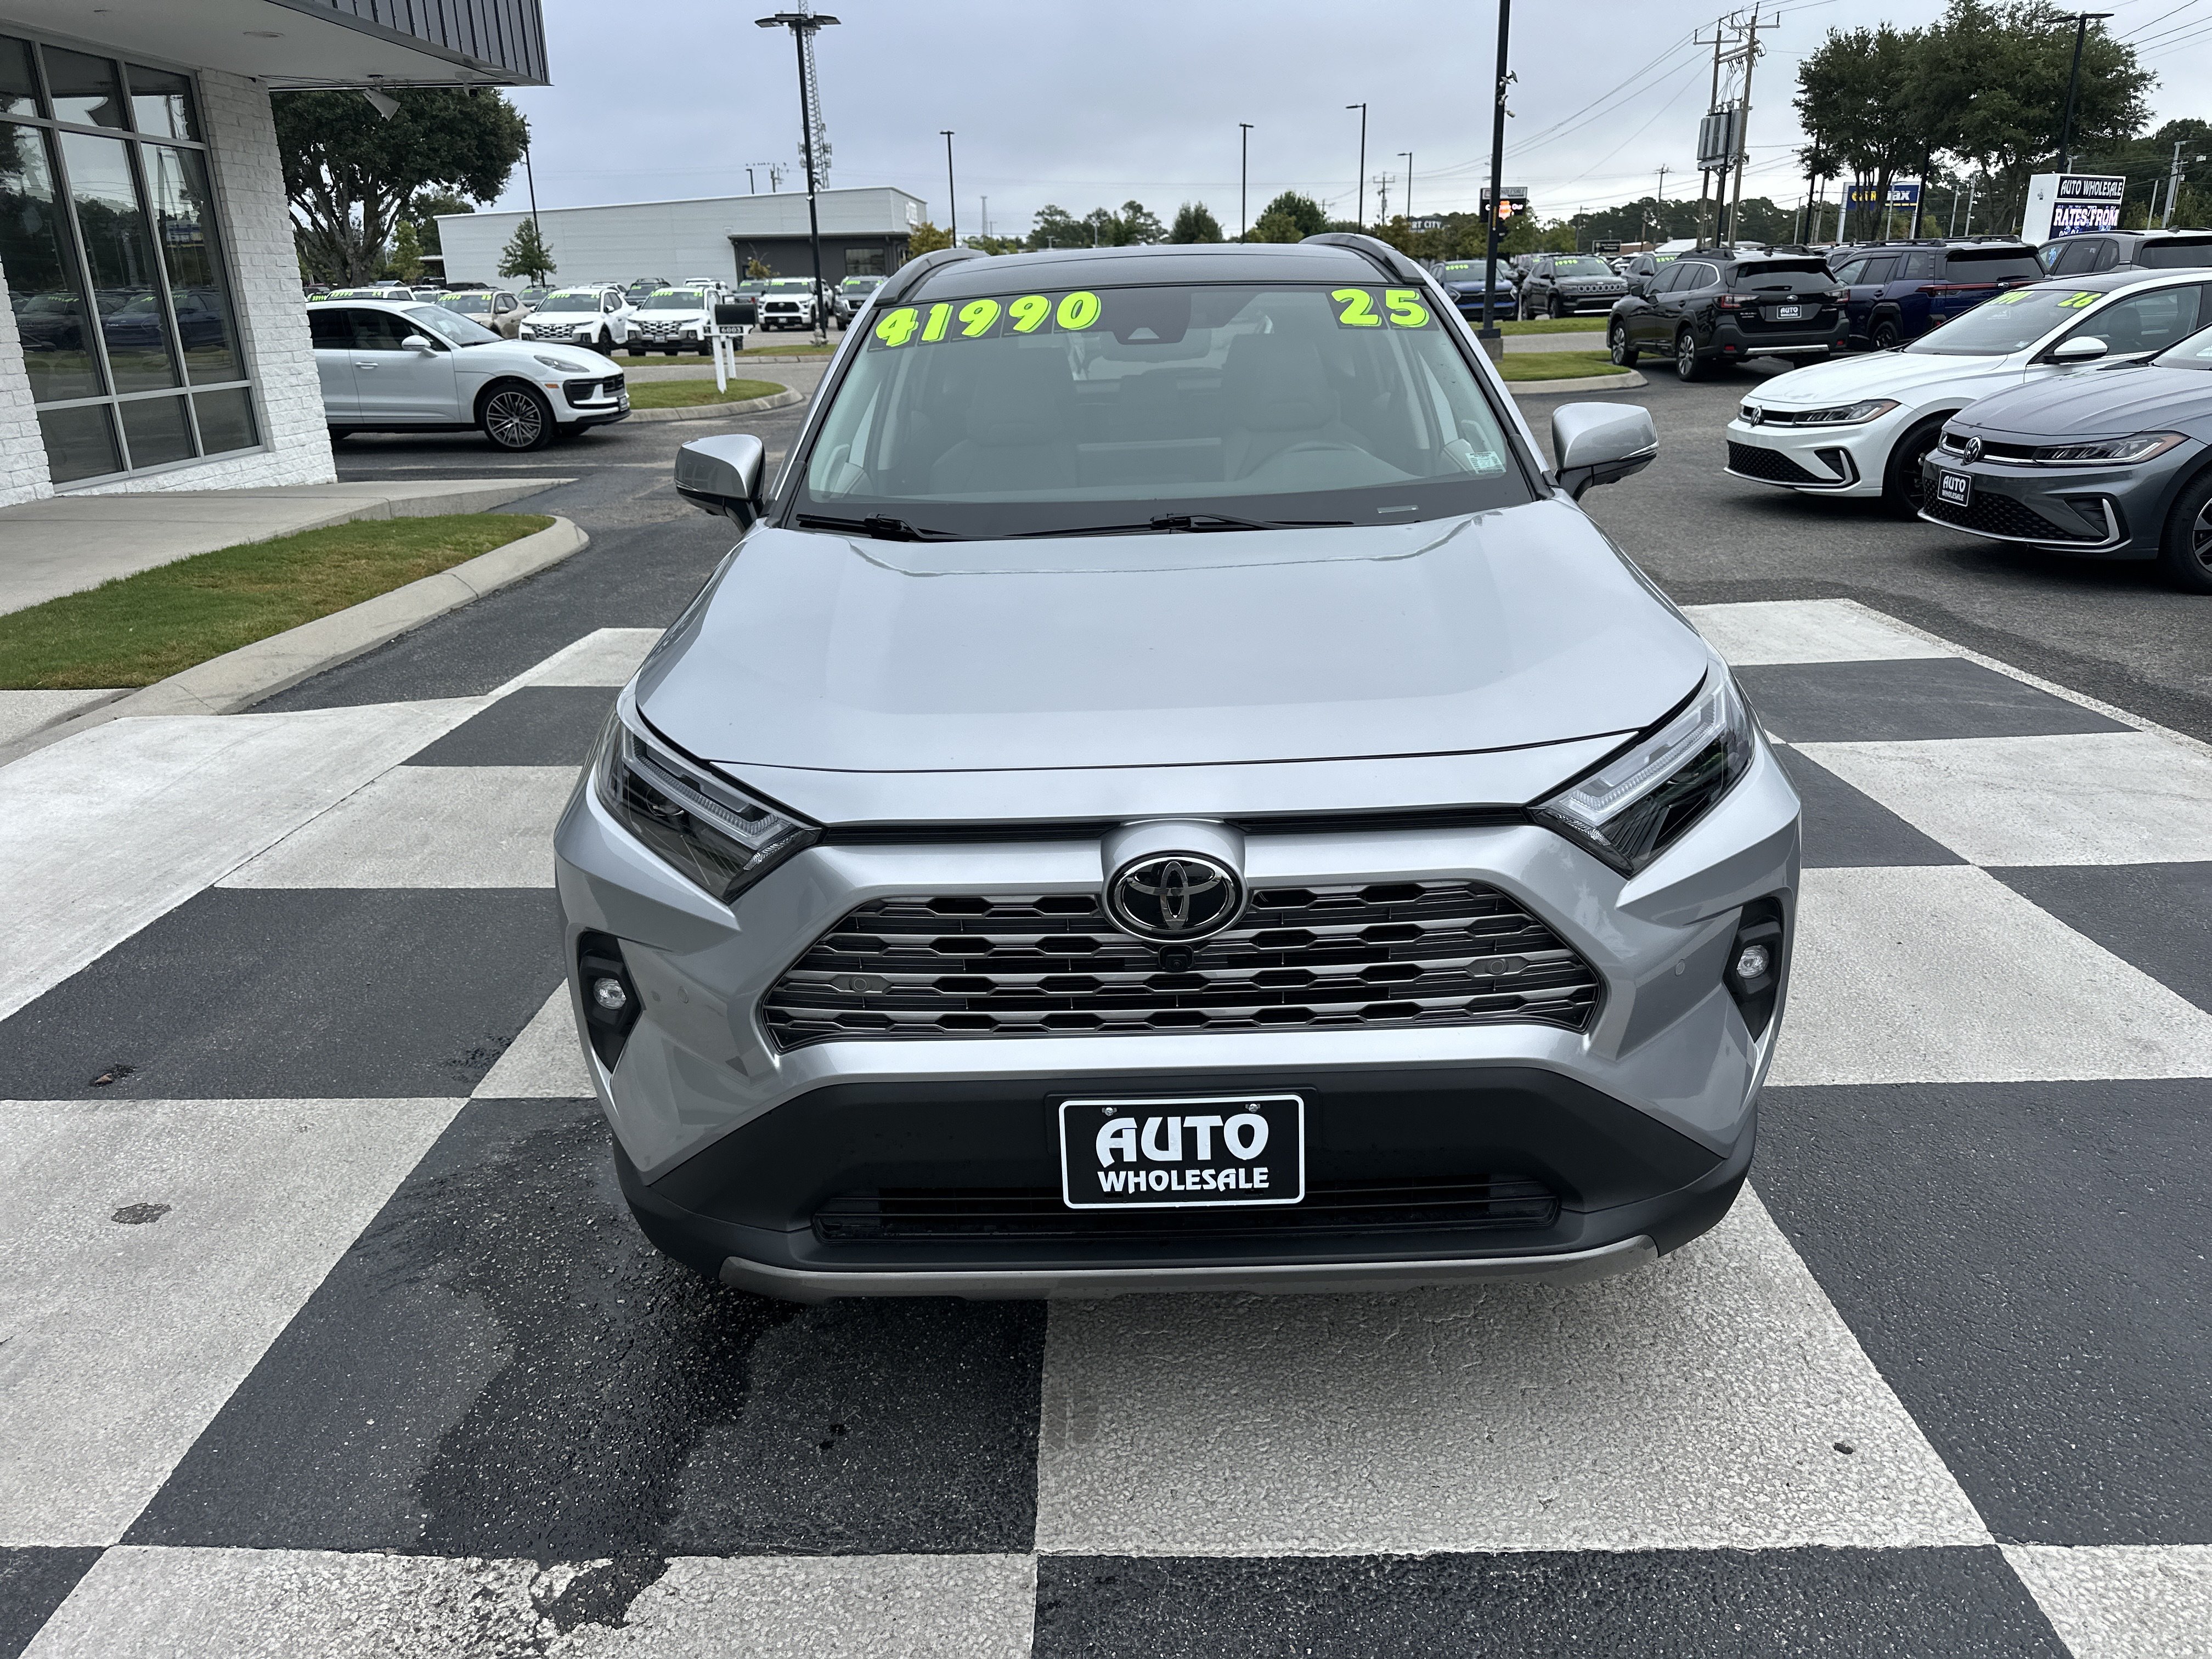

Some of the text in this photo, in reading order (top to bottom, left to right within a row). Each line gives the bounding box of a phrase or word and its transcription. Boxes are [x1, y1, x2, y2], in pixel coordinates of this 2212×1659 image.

[2061, 180, 2123, 197] AUTO WHOLESALE
[2053, 208, 2120, 227] RATES FROM
[1331, 289, 1430, 328] 25
[2057, 292, 2102, 308] 26
[876, 291, 1101, 347] 41990
[1943, 475, 1966, 493] AUTO
[1096, 1113, 1269, 1167] AUTO
[1097, 1167, 1269, 1194] WHOLESALE
